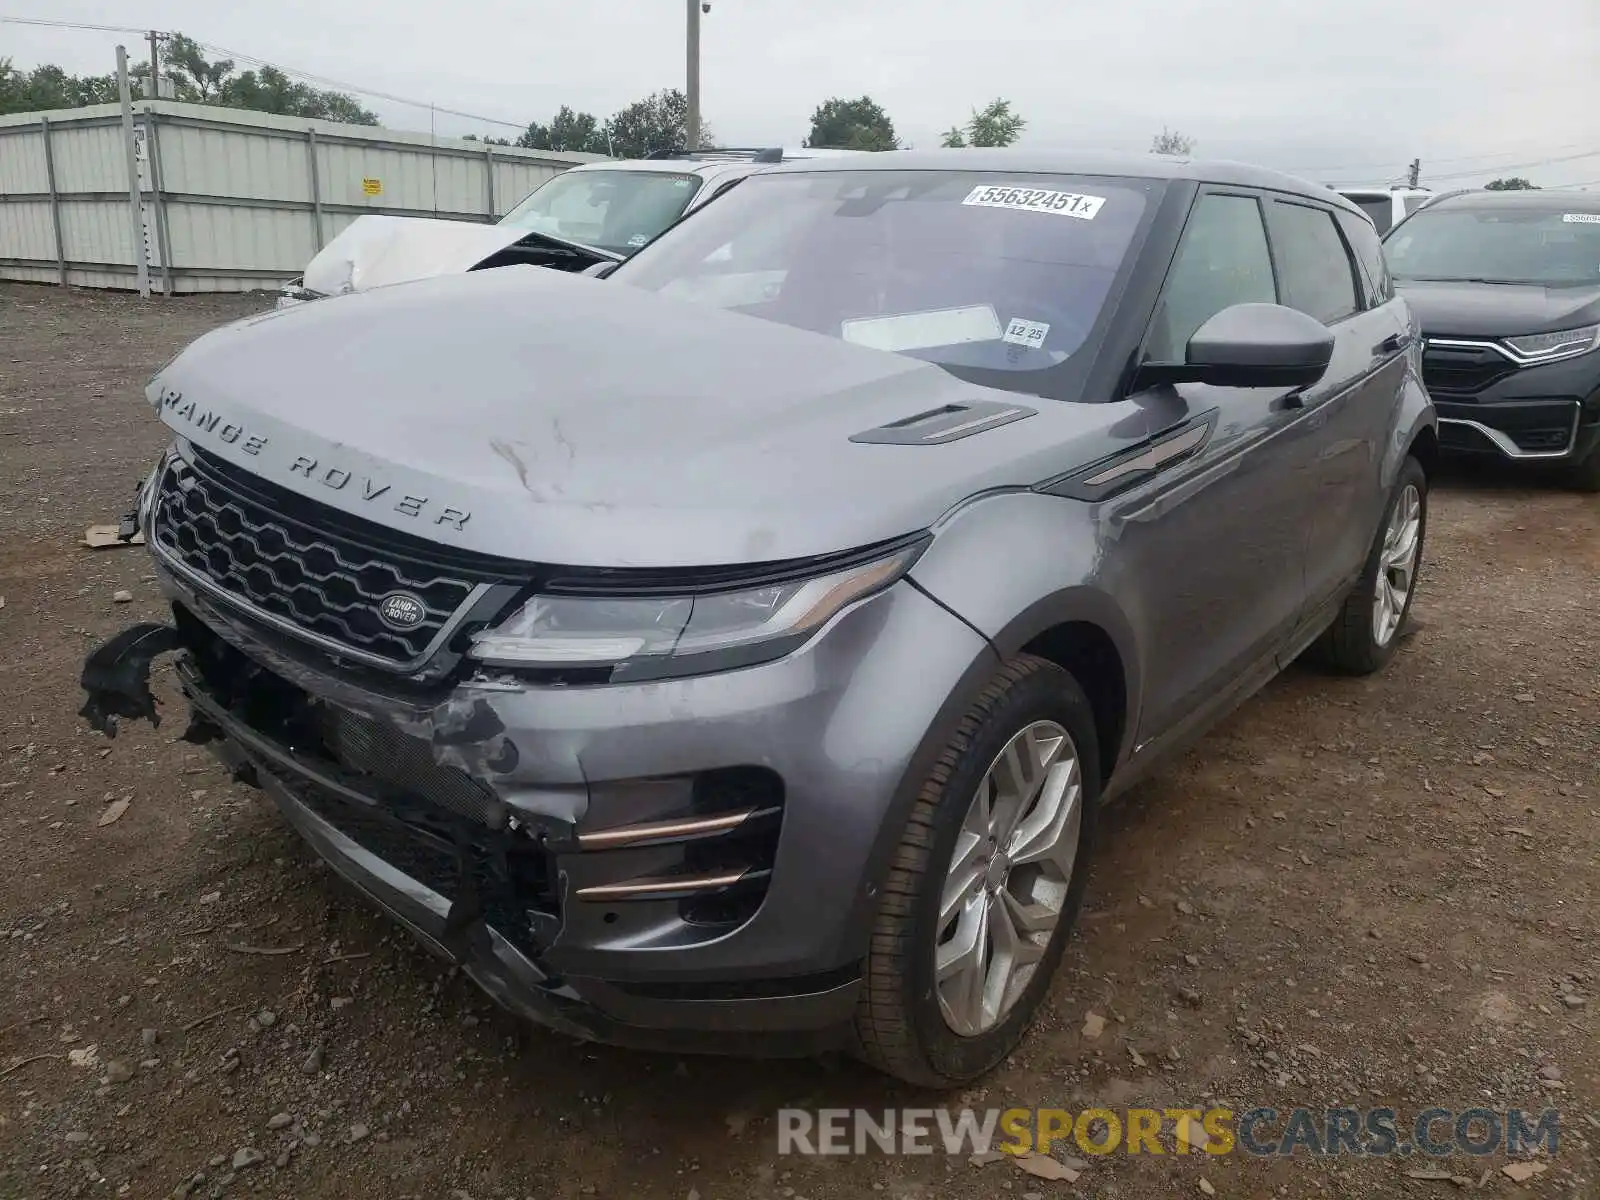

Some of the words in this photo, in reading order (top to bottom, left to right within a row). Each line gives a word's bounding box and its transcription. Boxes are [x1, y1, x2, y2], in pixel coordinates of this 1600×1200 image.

[1010, 325, 1025, 336] 12
[1028, 328, 1043, 340] 25
[164, 390, 268, 455] RANGE
[290, 454, 472, 532] ROVER
